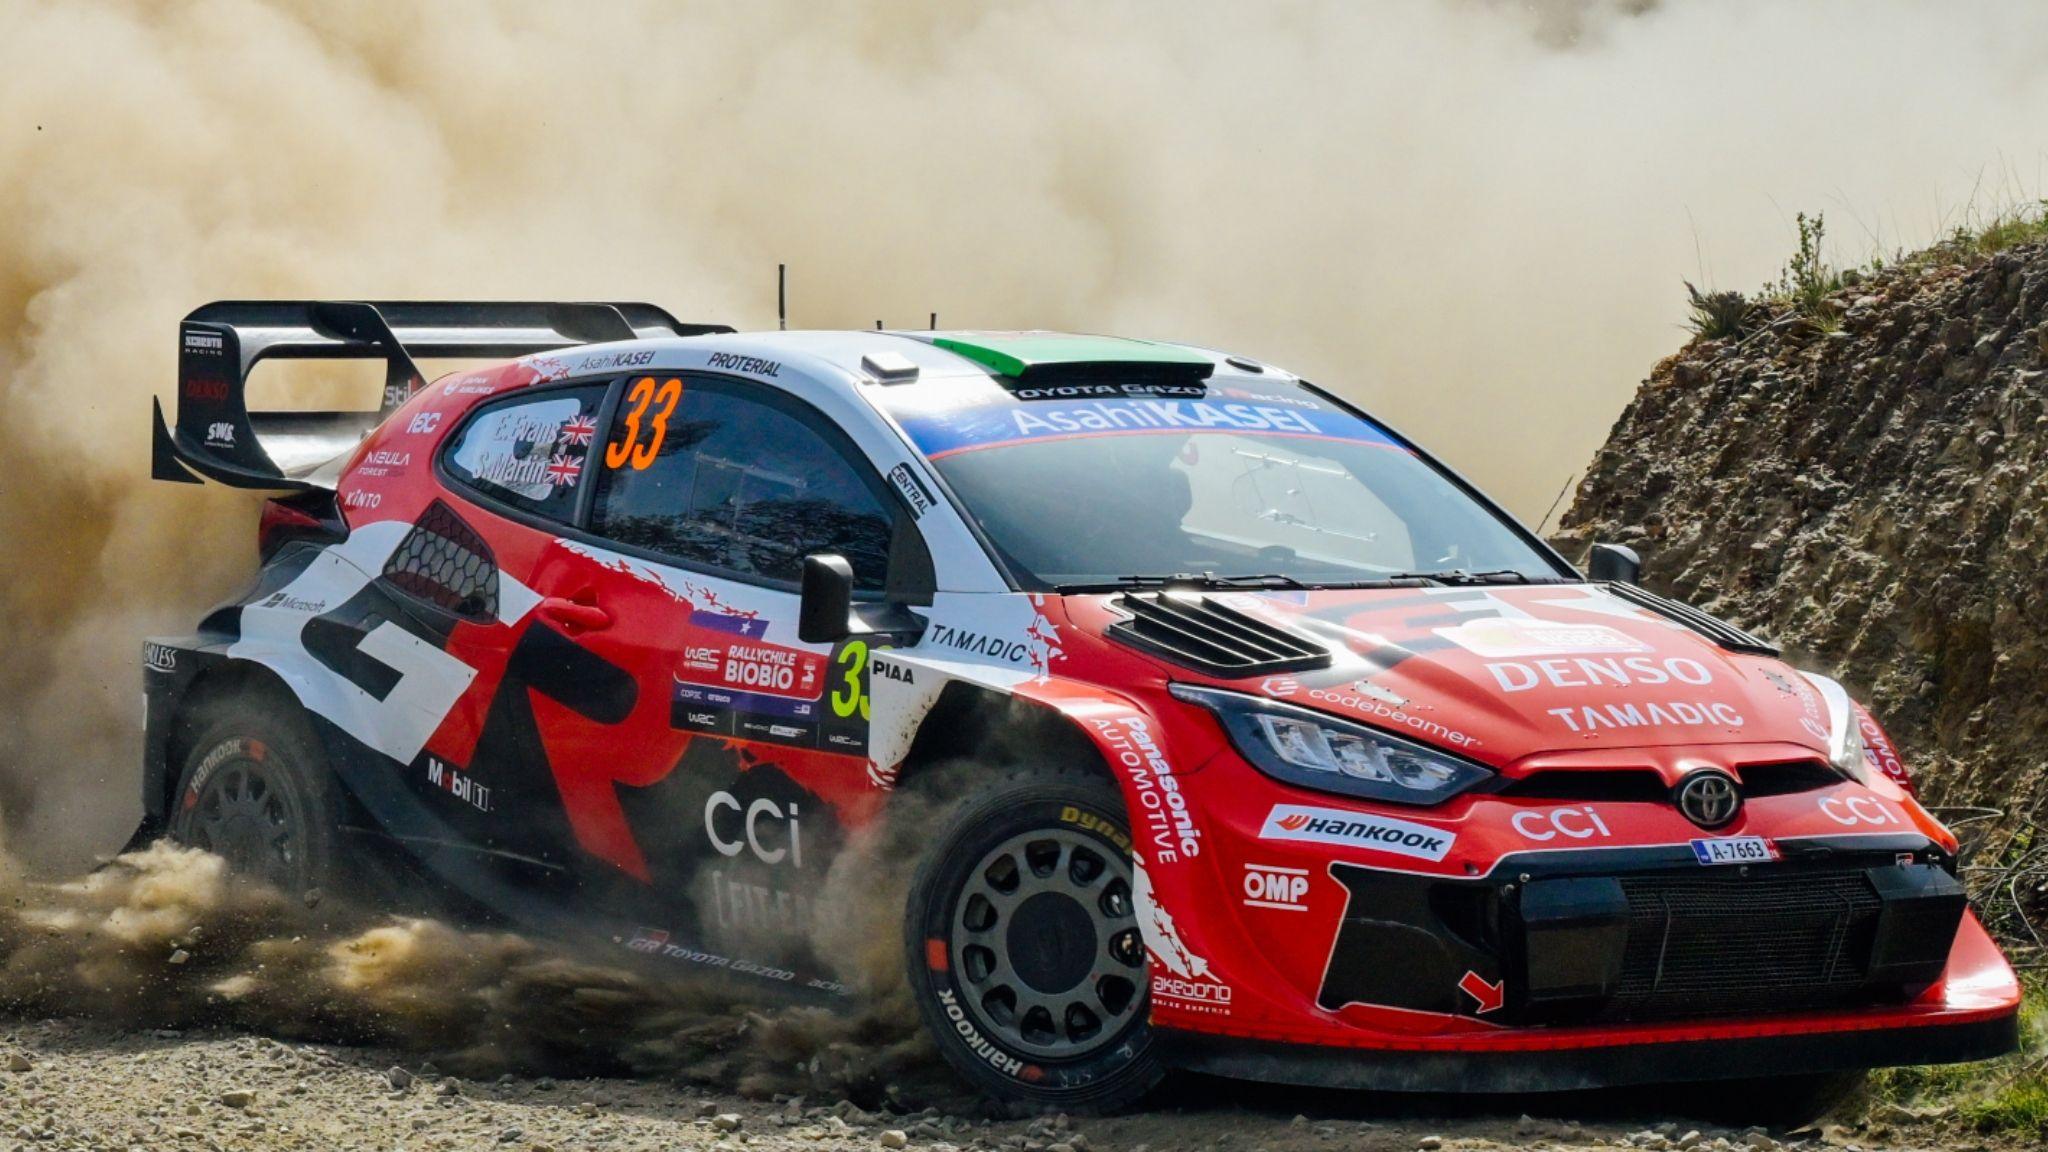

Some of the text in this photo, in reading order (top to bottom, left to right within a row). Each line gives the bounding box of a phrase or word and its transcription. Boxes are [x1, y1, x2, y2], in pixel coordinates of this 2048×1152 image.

[707, 352, 783, 378] PROTERIAL
[605, 376, 682, 470] 33
[1013, 401, 1323, 435] AsahiKASEI
[890, 465, 928, 515] CENTRAL
[684, 646, 721, 663] WRC
[932, 624, 1026, 662] TAMADIC
[873, 660, 915, 685] PIAA
[1484, 657, 1712, 692] DENSO
[1308, 688, 1478, 748] codebeamer
[1547, 702, 1744, 732] TAMADIC
[428, 758, 471, 803] Mobil
[1090, 718, 1178, 864] AUTOMOTIVE
[1117, 717, 1201, 857] Panasonic
[1712, 841, 1764, 860] A-7663
[1244, 871, 1309, 903] OMP
[663, 944, 730, 967] TOYOTA
[730, 960, 796, 981] GAZOO
[1153, 975, 1232, 1001] akebono
